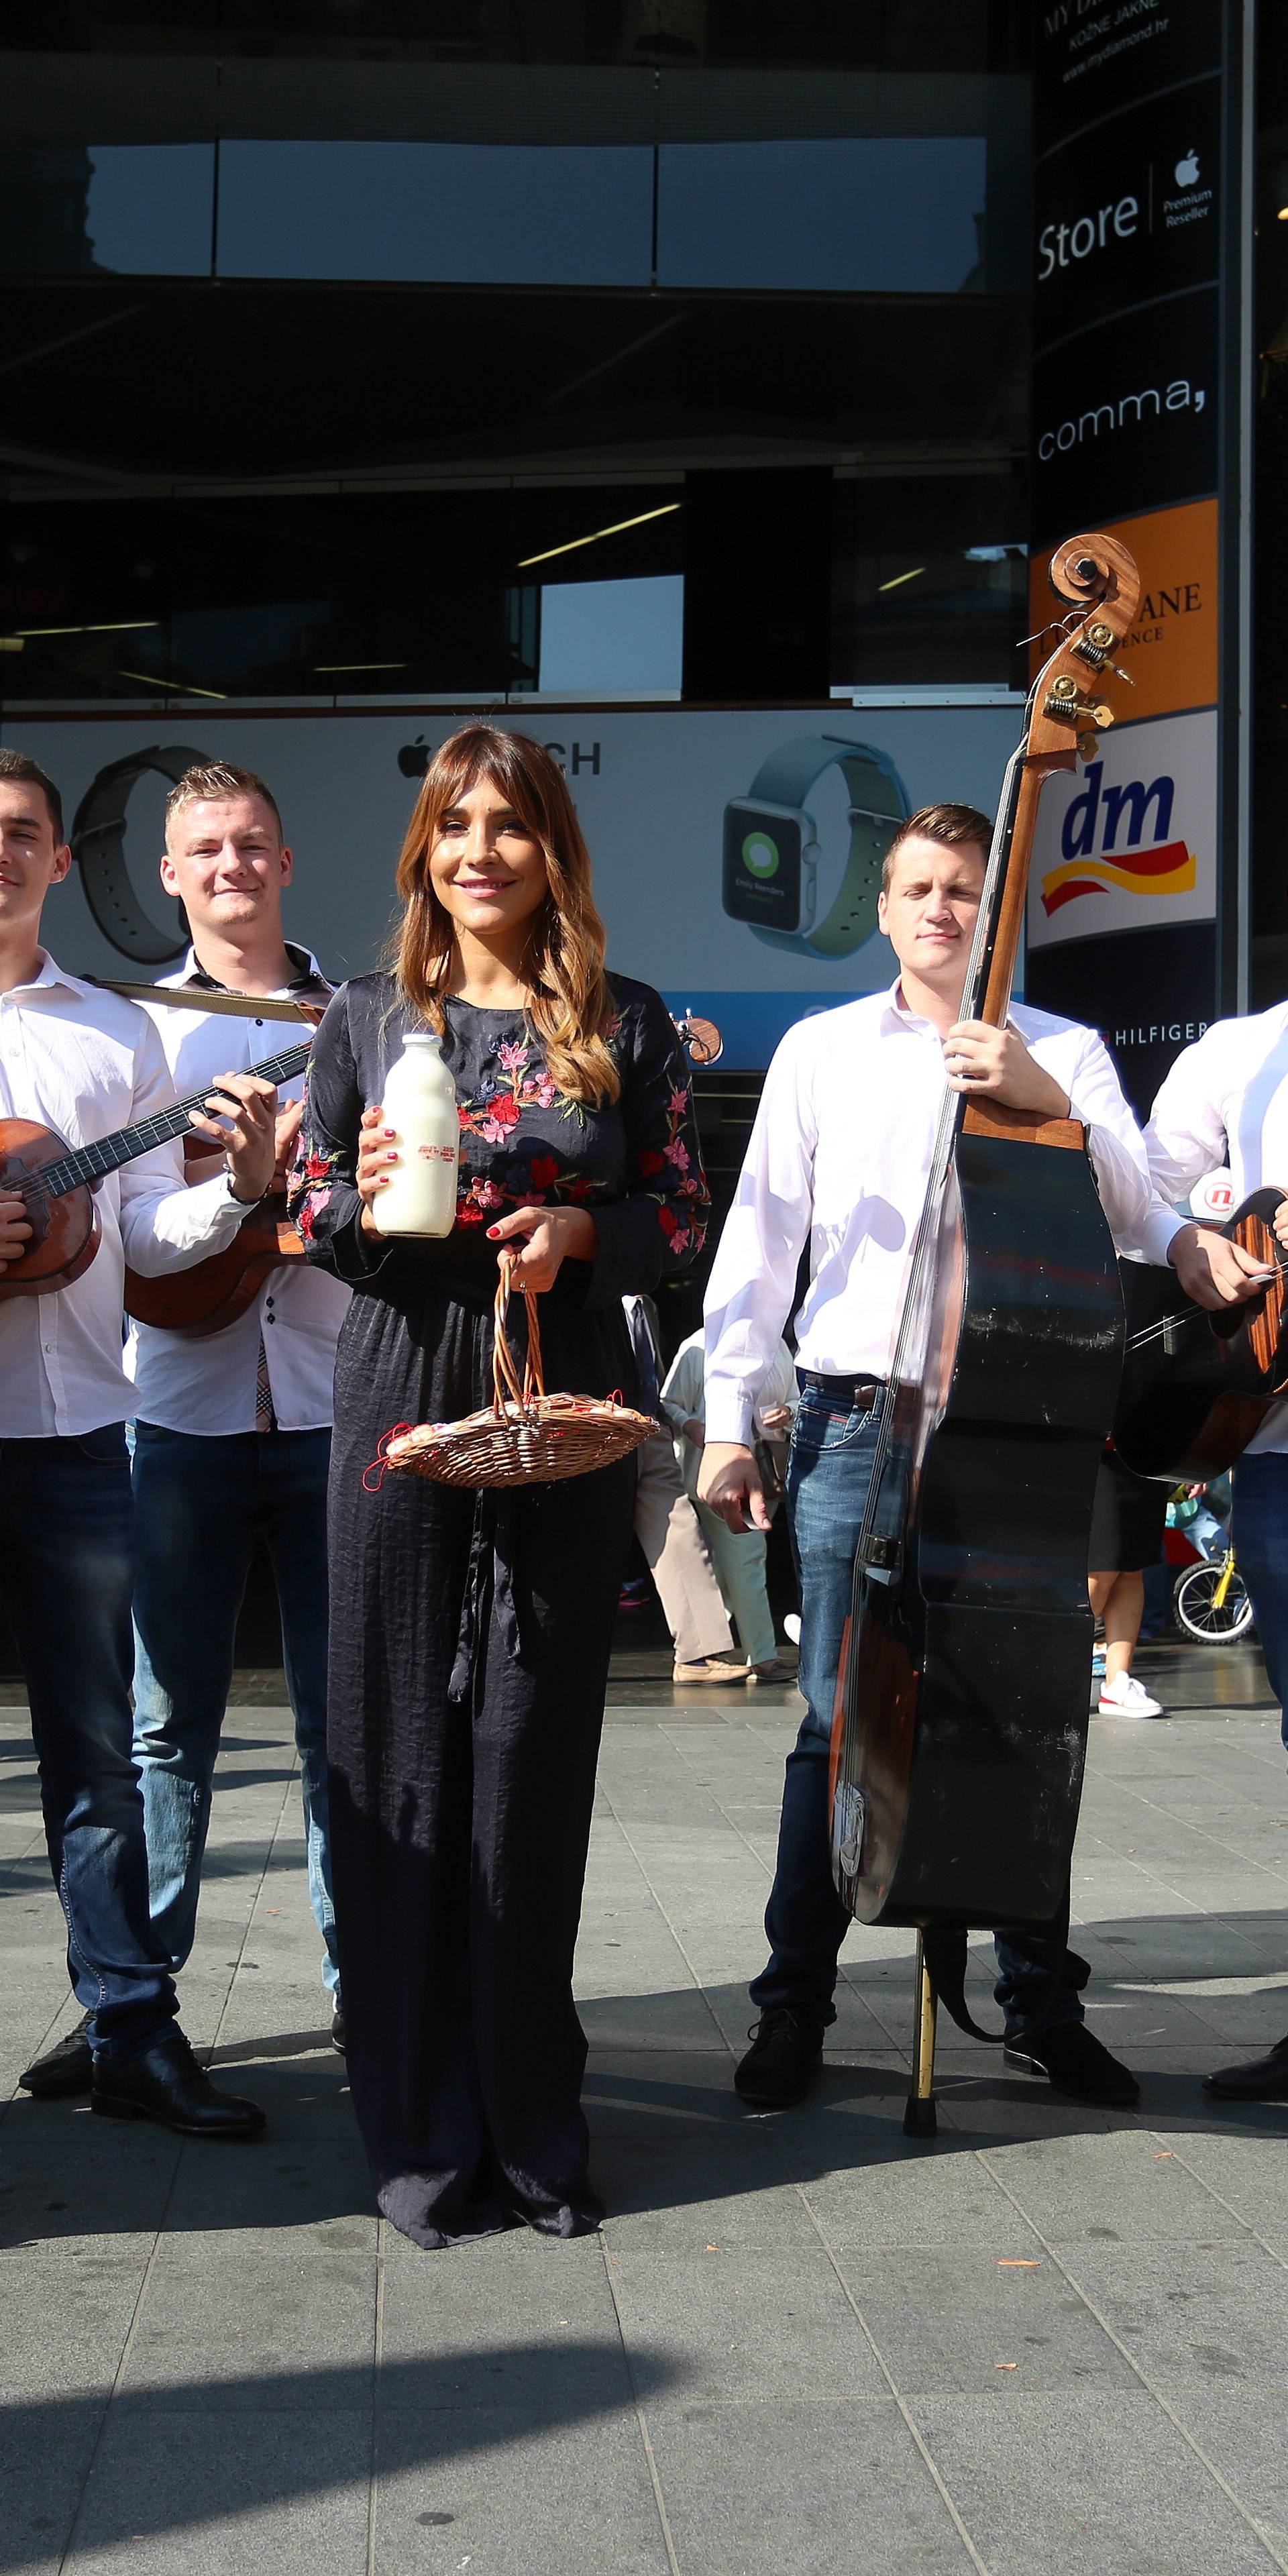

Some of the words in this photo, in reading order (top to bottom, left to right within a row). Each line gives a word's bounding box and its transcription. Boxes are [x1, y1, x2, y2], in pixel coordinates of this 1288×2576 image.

[1163, 190, 1212, 214] Premium
[1166, 206, 1209, 229] Reseller
[1038, 197, 1138, 280] Store
[1039, 379, 1205, 460] comma,
[1061, 761, 1175, 861] dm
[1116, 1022, 1208, 1046] HILFIGER
